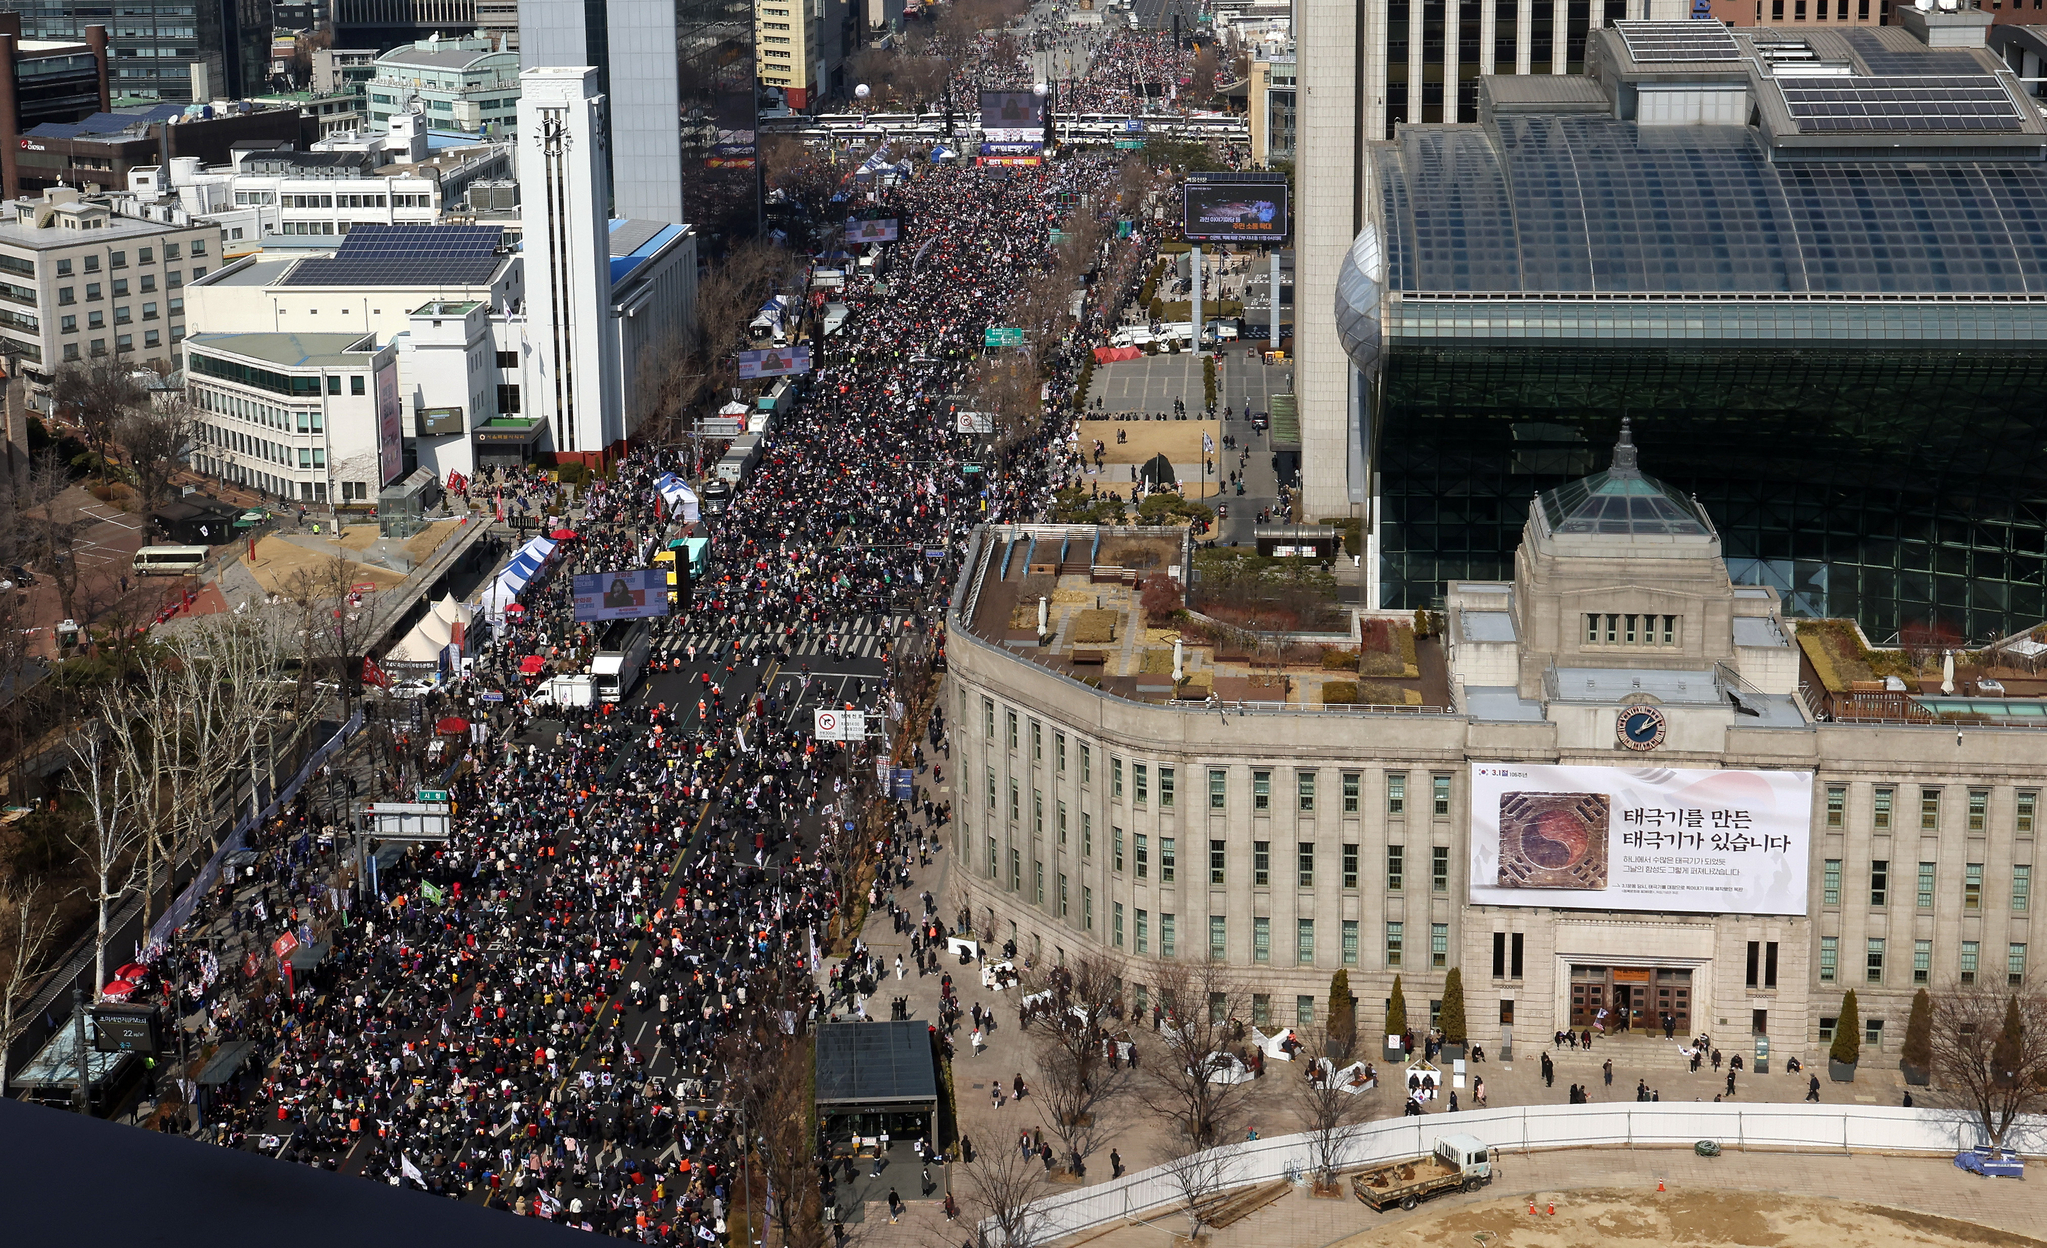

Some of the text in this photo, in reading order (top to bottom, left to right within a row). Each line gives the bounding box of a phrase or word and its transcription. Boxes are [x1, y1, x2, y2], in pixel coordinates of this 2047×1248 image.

[1623, 807, 1752, 830] 태극기를 만든
[1623, 830, 1791, 853] 태극기가 있습니다
[1623, 855, 1726, 866] 하나에서 수많은 태극기가 되었듯
[1623, 865, 1740, 876] 그날의 함성도 그렇게 퍼져나갔습니다
[123, 1029, 133, 1037] 22
